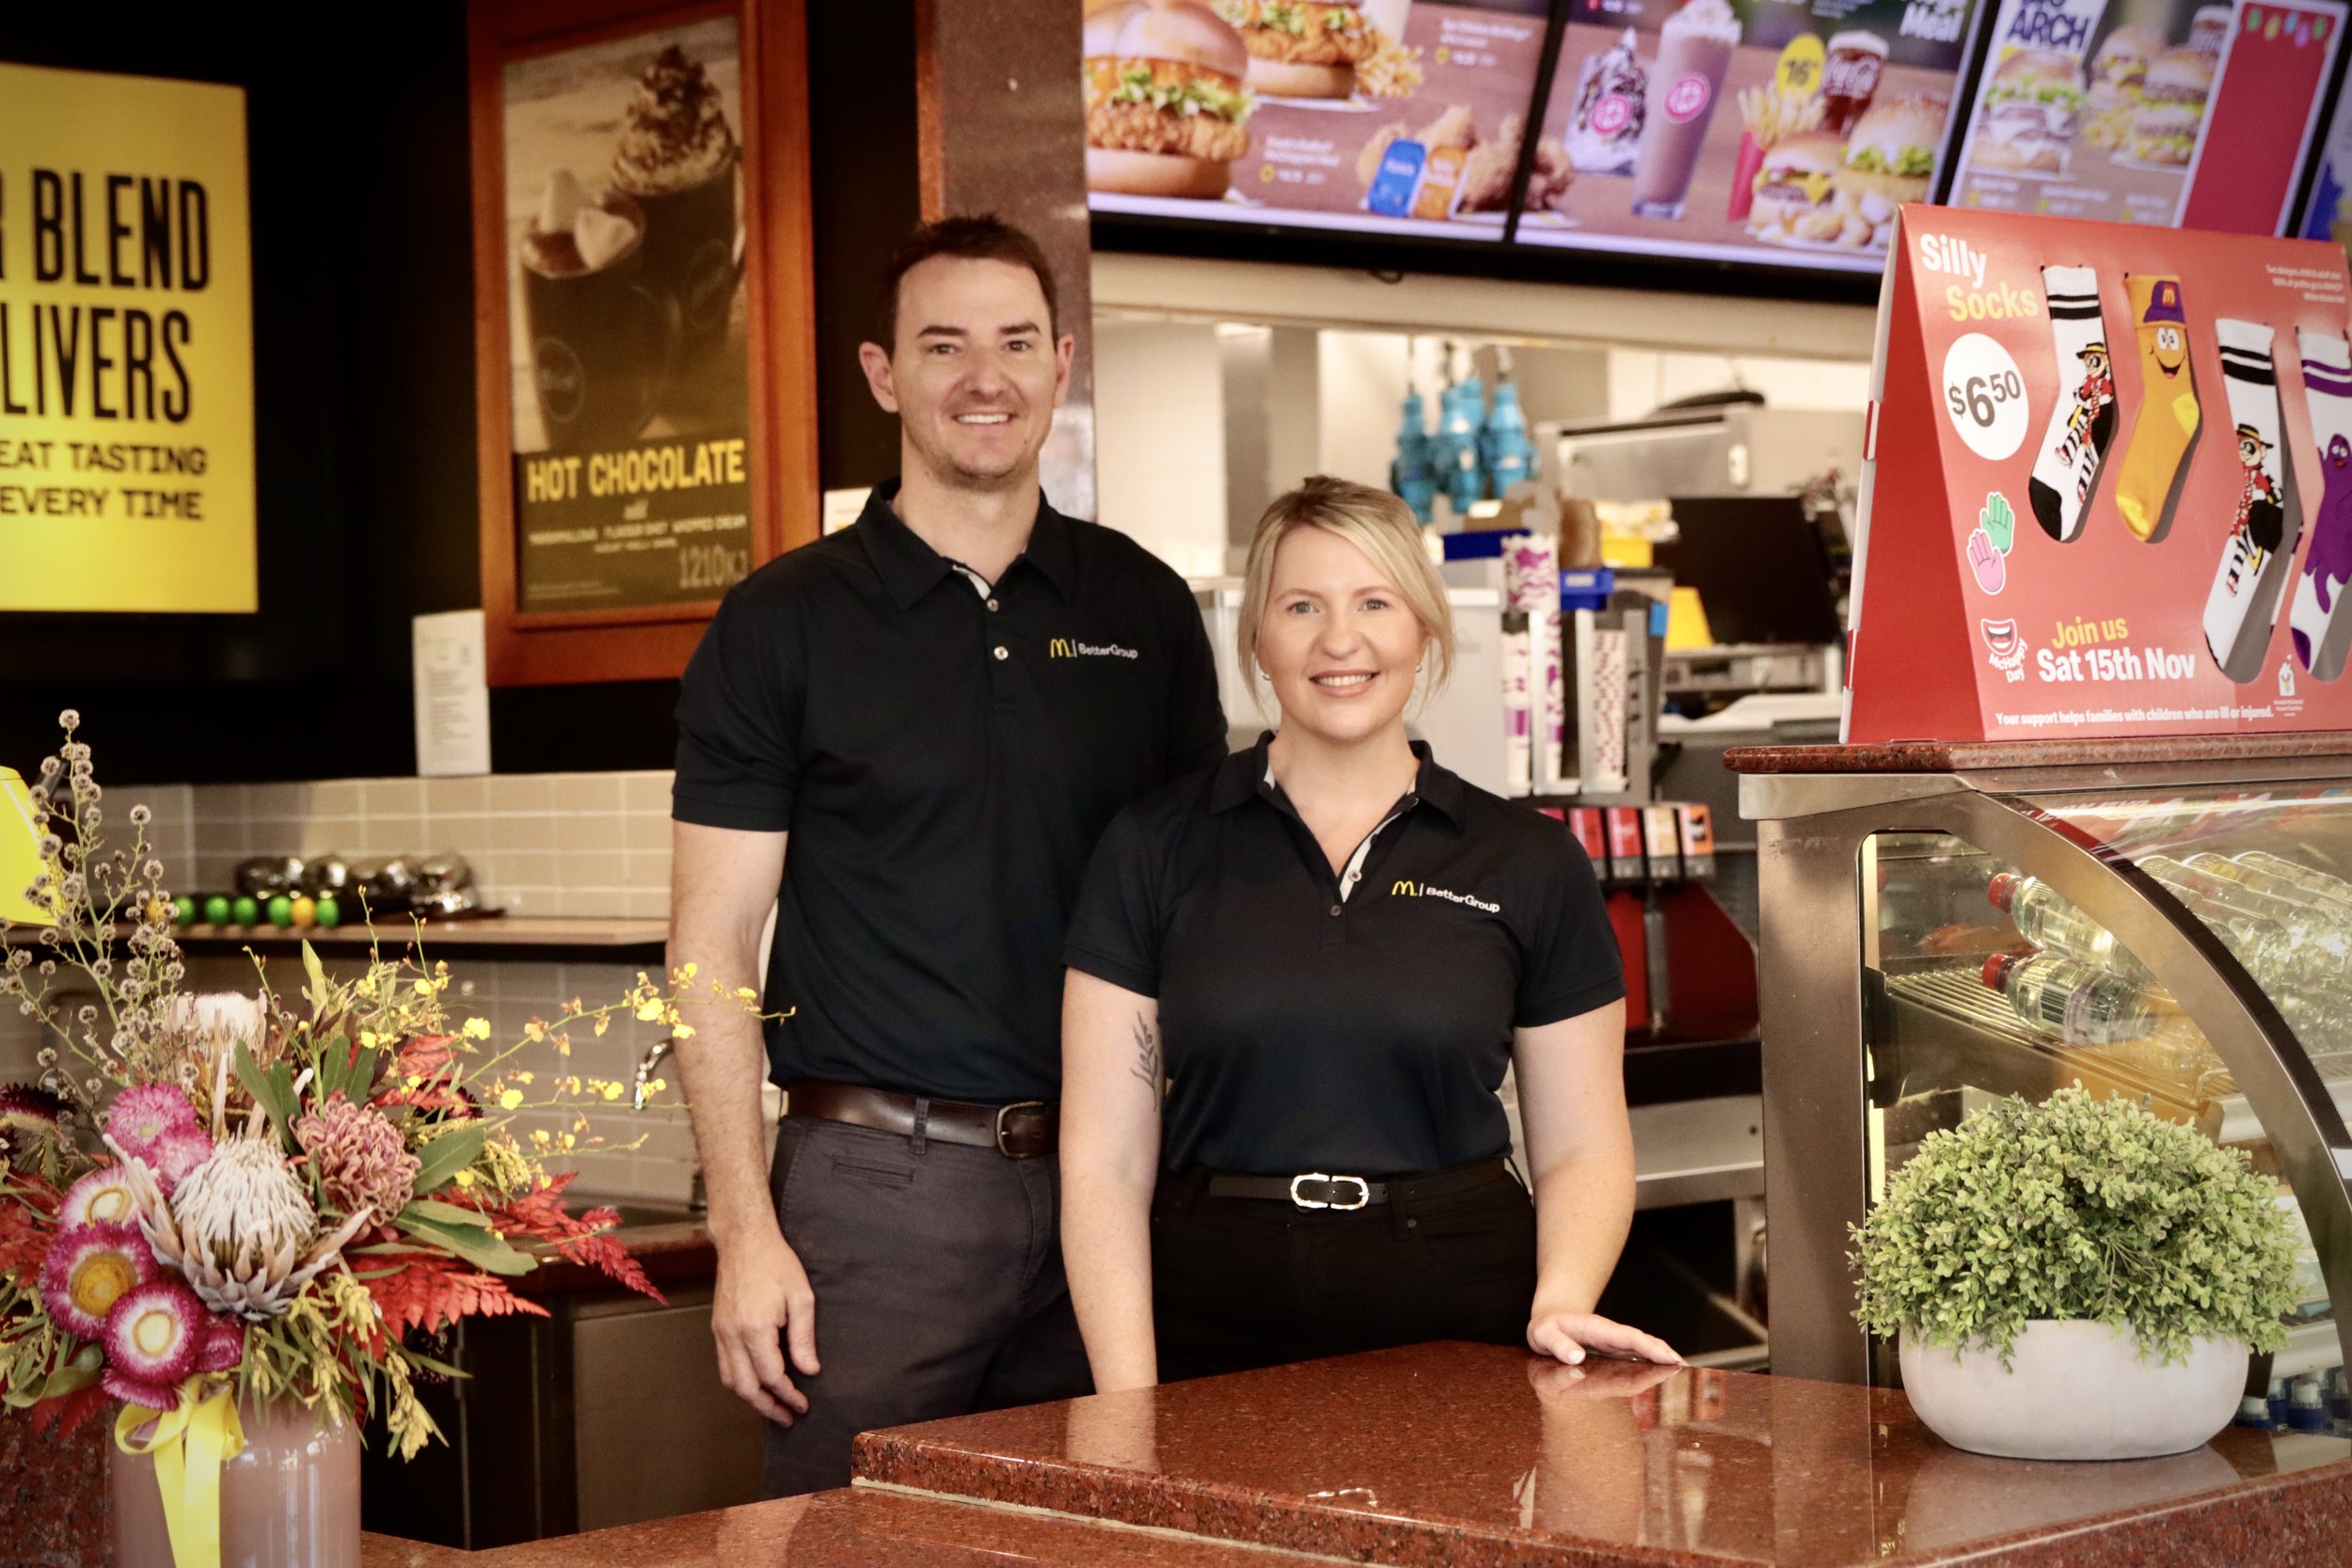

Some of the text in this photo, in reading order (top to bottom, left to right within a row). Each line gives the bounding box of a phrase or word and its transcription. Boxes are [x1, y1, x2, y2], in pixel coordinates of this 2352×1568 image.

[2008, 8, 2090, 48] ARCH
[32, 167, 209, 292] BLEND
[1920, 233, 1987, 289] Silly
[1946, 282, 2040, 322] Socks
[69, 443, 206, 475] TASTING
[527, 438, 746, 502] HOT CHOCOLATE
[0, 485, 203, 520] EVERY TIME
[2052, 616, 2129, 649] Join us
[1078, 642, 1138, 659] BetterGroup
[1988, 637, 2028, 671] McHappy
[2037, 646, 2196, 683] Sat 15th Nov
[2006, 664, 2026, 684] Day
[1994, 713, 2020, 725] Your
[2020, 711, 2058, 727] support
[2058, 710, 2085, 726] helps
[2086, 708, 2123, 722] families
[2124, 707, 2145, 721] with
[2146, 707, 2184, 721] children
[2184, 707, 2203, 720] who
[2204, 709, 2219, 720] are
[2219, 705, 2230, 719] ill
[2230, 708, 2240, 719] or
[2240, 705, 2274, 721] injured.
[1425, 886, 1501, 913] BetterGroup
